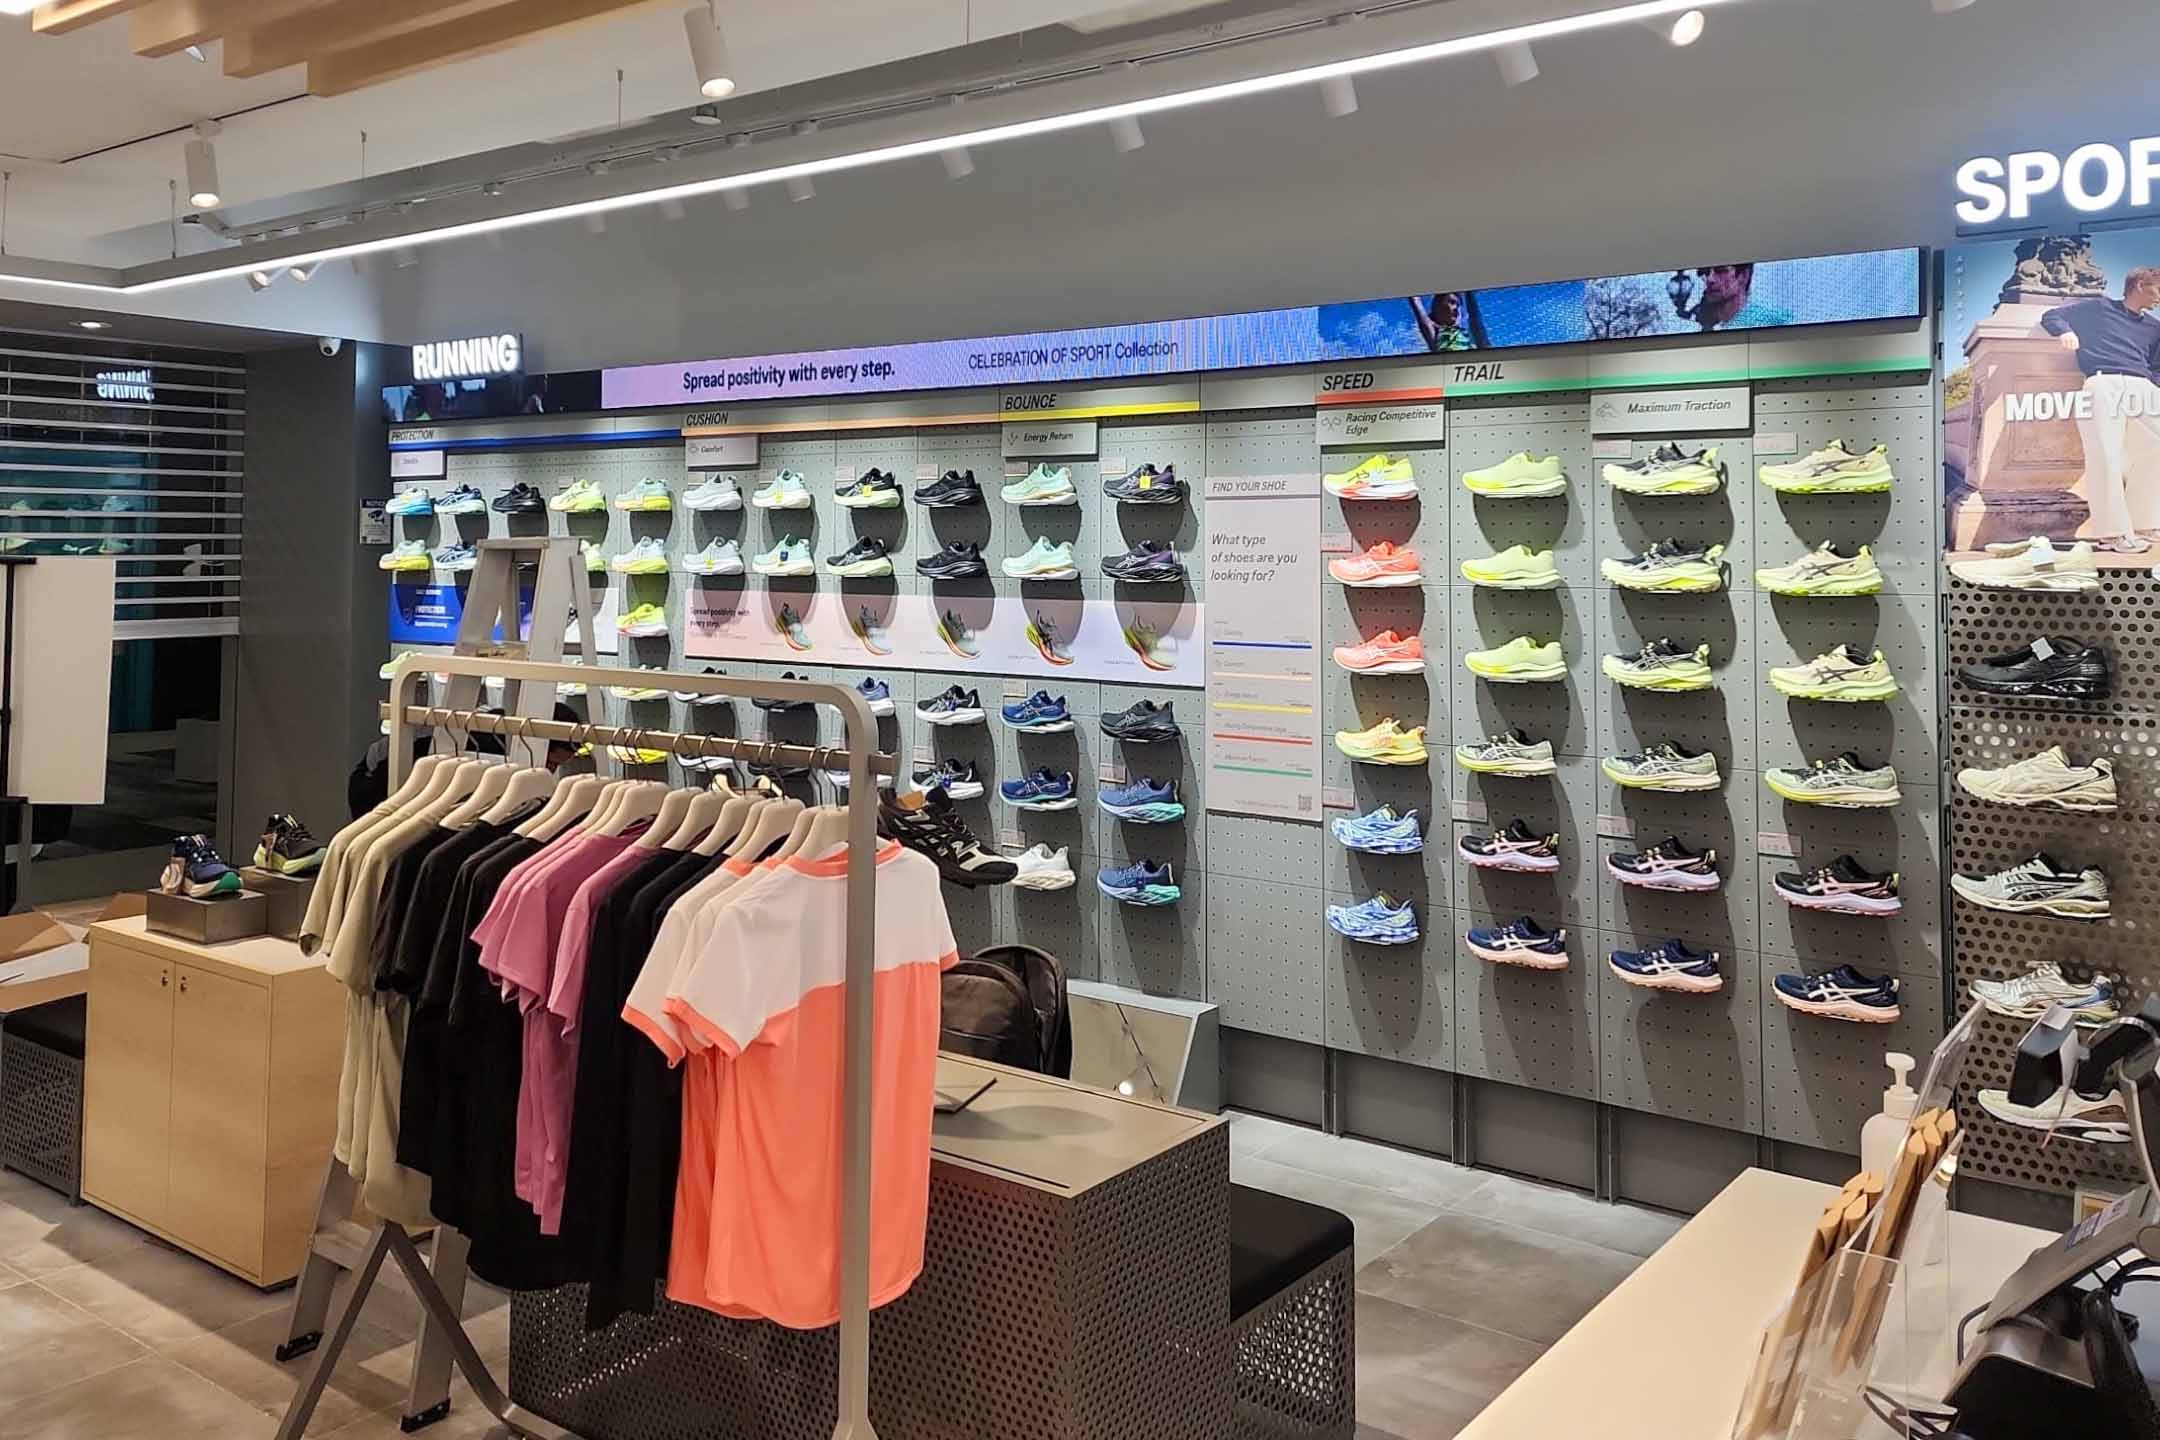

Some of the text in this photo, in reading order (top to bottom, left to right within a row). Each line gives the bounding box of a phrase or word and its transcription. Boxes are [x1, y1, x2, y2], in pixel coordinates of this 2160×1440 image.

[412, 334, 519, 380] RUNNING
[968, 341, 1179, 369] CELEBRATION OF SPORT Collection
[683, 360, 896, 393] Spread positivity with every step.
[1454, 363, 1505, 383] TRAIL
[1322, 372, 1375, 391] SPEED
[1005, 394, 1057, 410] BOUNCE
[1627, 399, 1731, 414] Maximum Traction
[2005, 390, 2094, 422] MOVE
[686, 412, 729, 426] CUSHION
[1345, 409, 1437, 424] Racing Competitive
[391, 429, 434, 441] PROTECTION
[1023, 431, 1074, 444] Energy Return
[1345, 425, 1369, 437] Edge
[1212, 480, 1288, 493] FIND YOUR SHOE
[1212, 533, 1267, 548] What type
[1211, 551, 1298, 566] of shoes are you
[1210, 568, 1275, 584] looking for?
